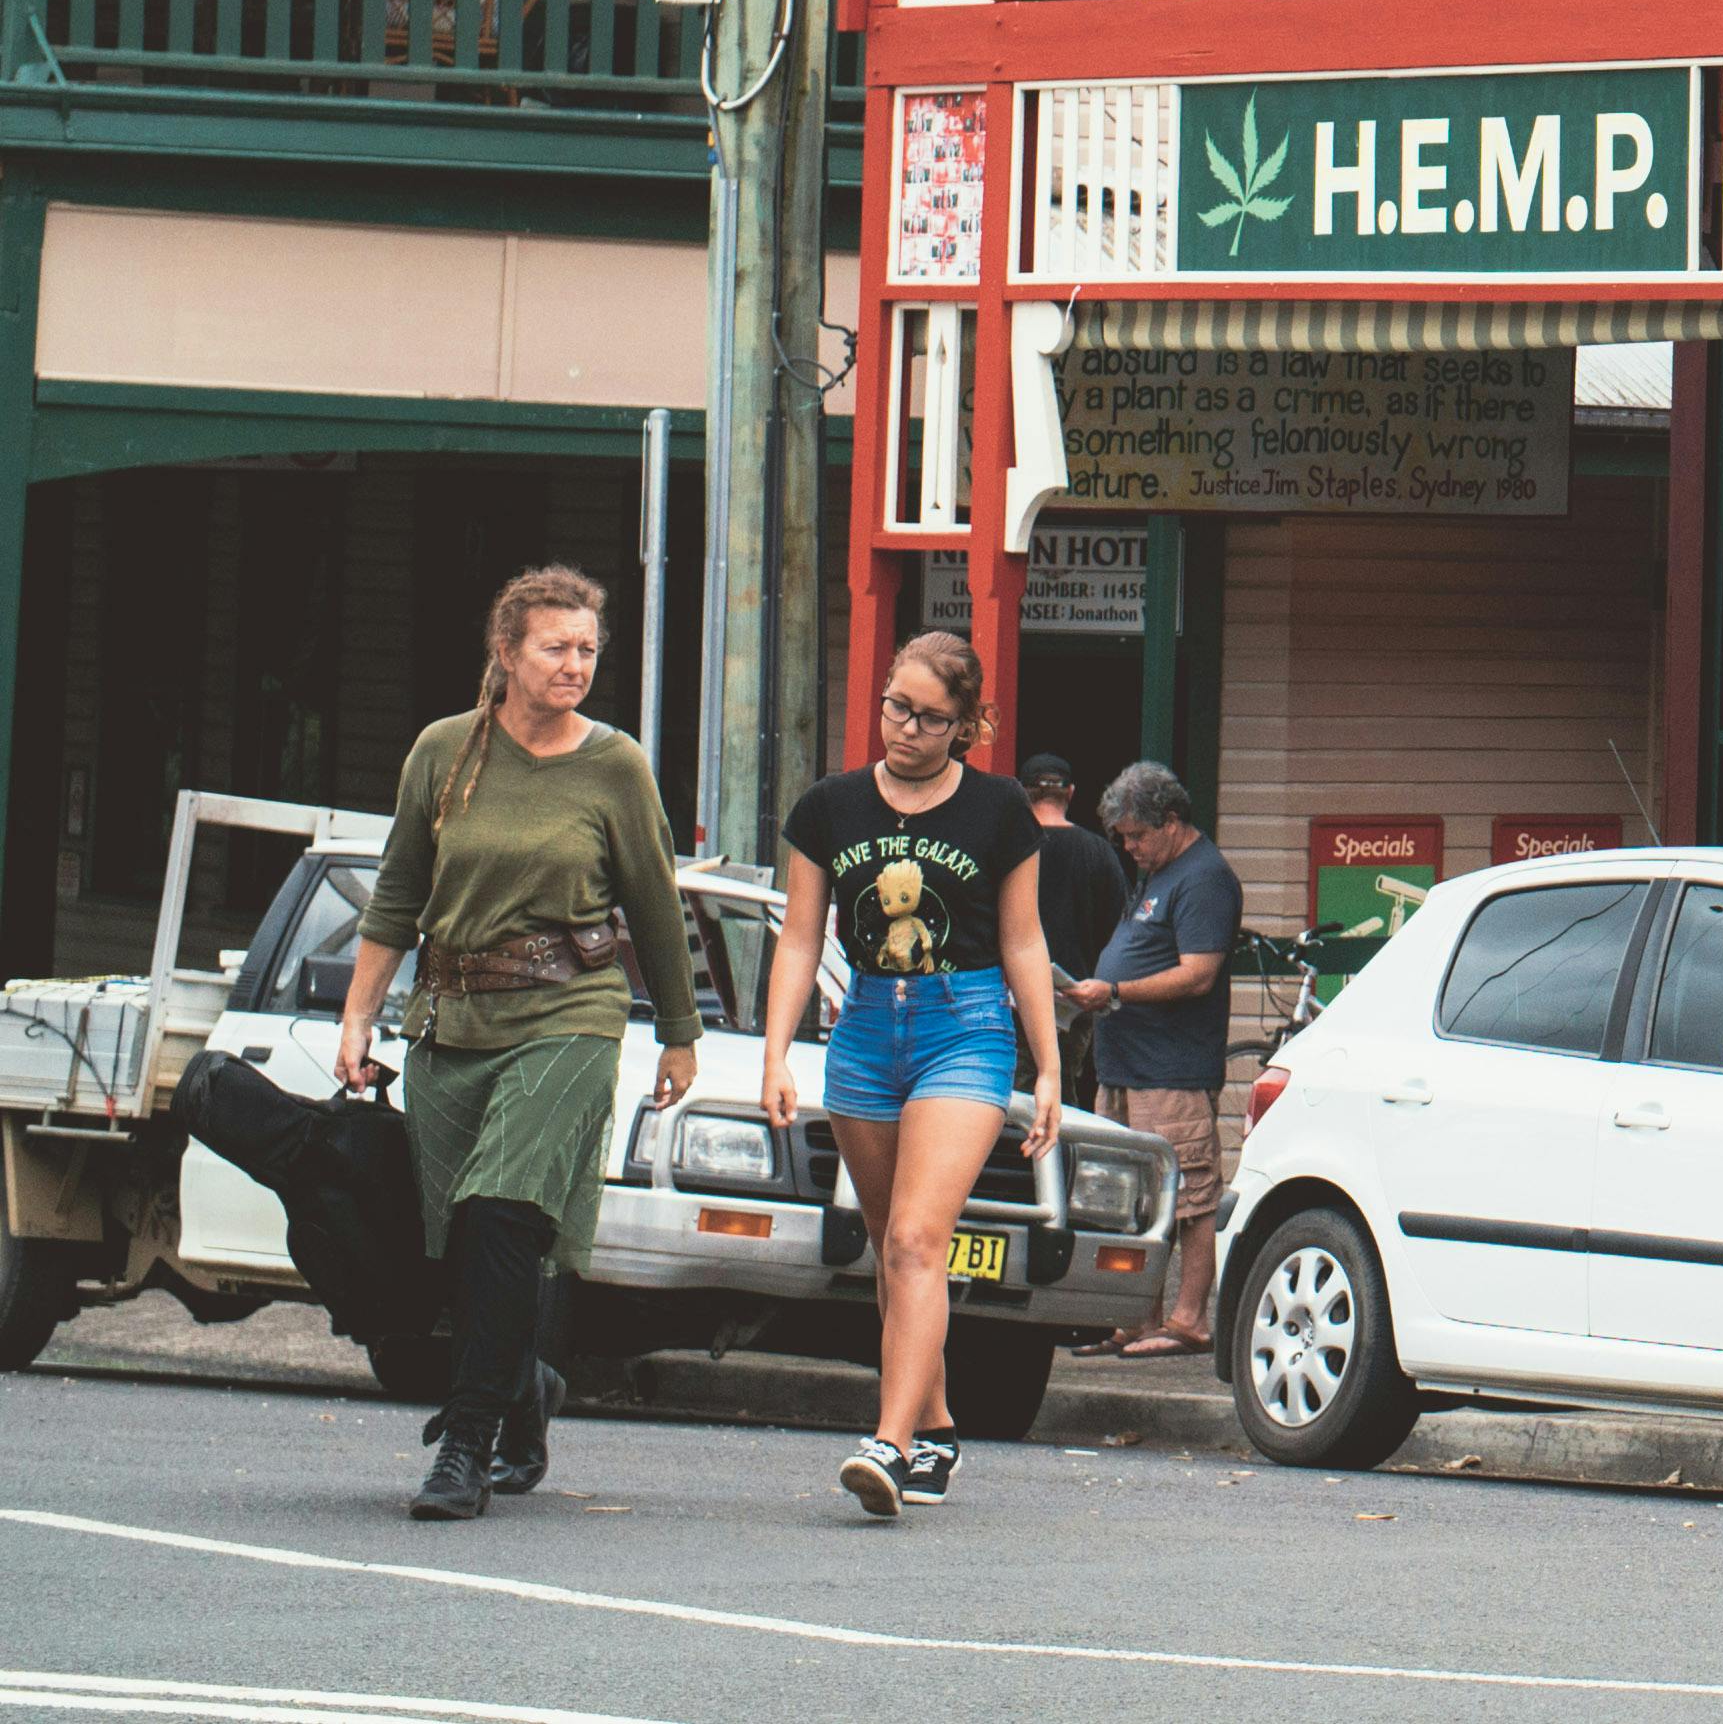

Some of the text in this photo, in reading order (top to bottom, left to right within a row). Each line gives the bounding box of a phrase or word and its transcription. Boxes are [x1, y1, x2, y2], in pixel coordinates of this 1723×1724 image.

[1312, 111, 1669, 237] H.E.M.P.
[1247, 352, 1269, 377] a
[1423, 350, 1514, 387] seeks
[1521, 350, 1548, 388] to
[1084, 385, 1104, 410] a
[1111, 378, 1188, 425] plant
[1194, 385, 1230, 412] as
[1236, 385, 1257, 413] a
[1386, 391, 1419, 416] as
[1424, 384, 1447, 422] if
[1455, 381, 1536, 422] there
[1065, 417, 1529, 478] something feloniously wrong
[1189, 468, 1261, 496] Justice
[1262, 467, 1300, 495] Jim
[1408, 464, 1488, 508] Sydney
[1495, 478, 1538, 501] 1980
[832, 835, 980, 881] SAVE THE GALAXY
[1333, 832, 1415, 864] Specials
[1515, 831, 1595, 859] Specials
